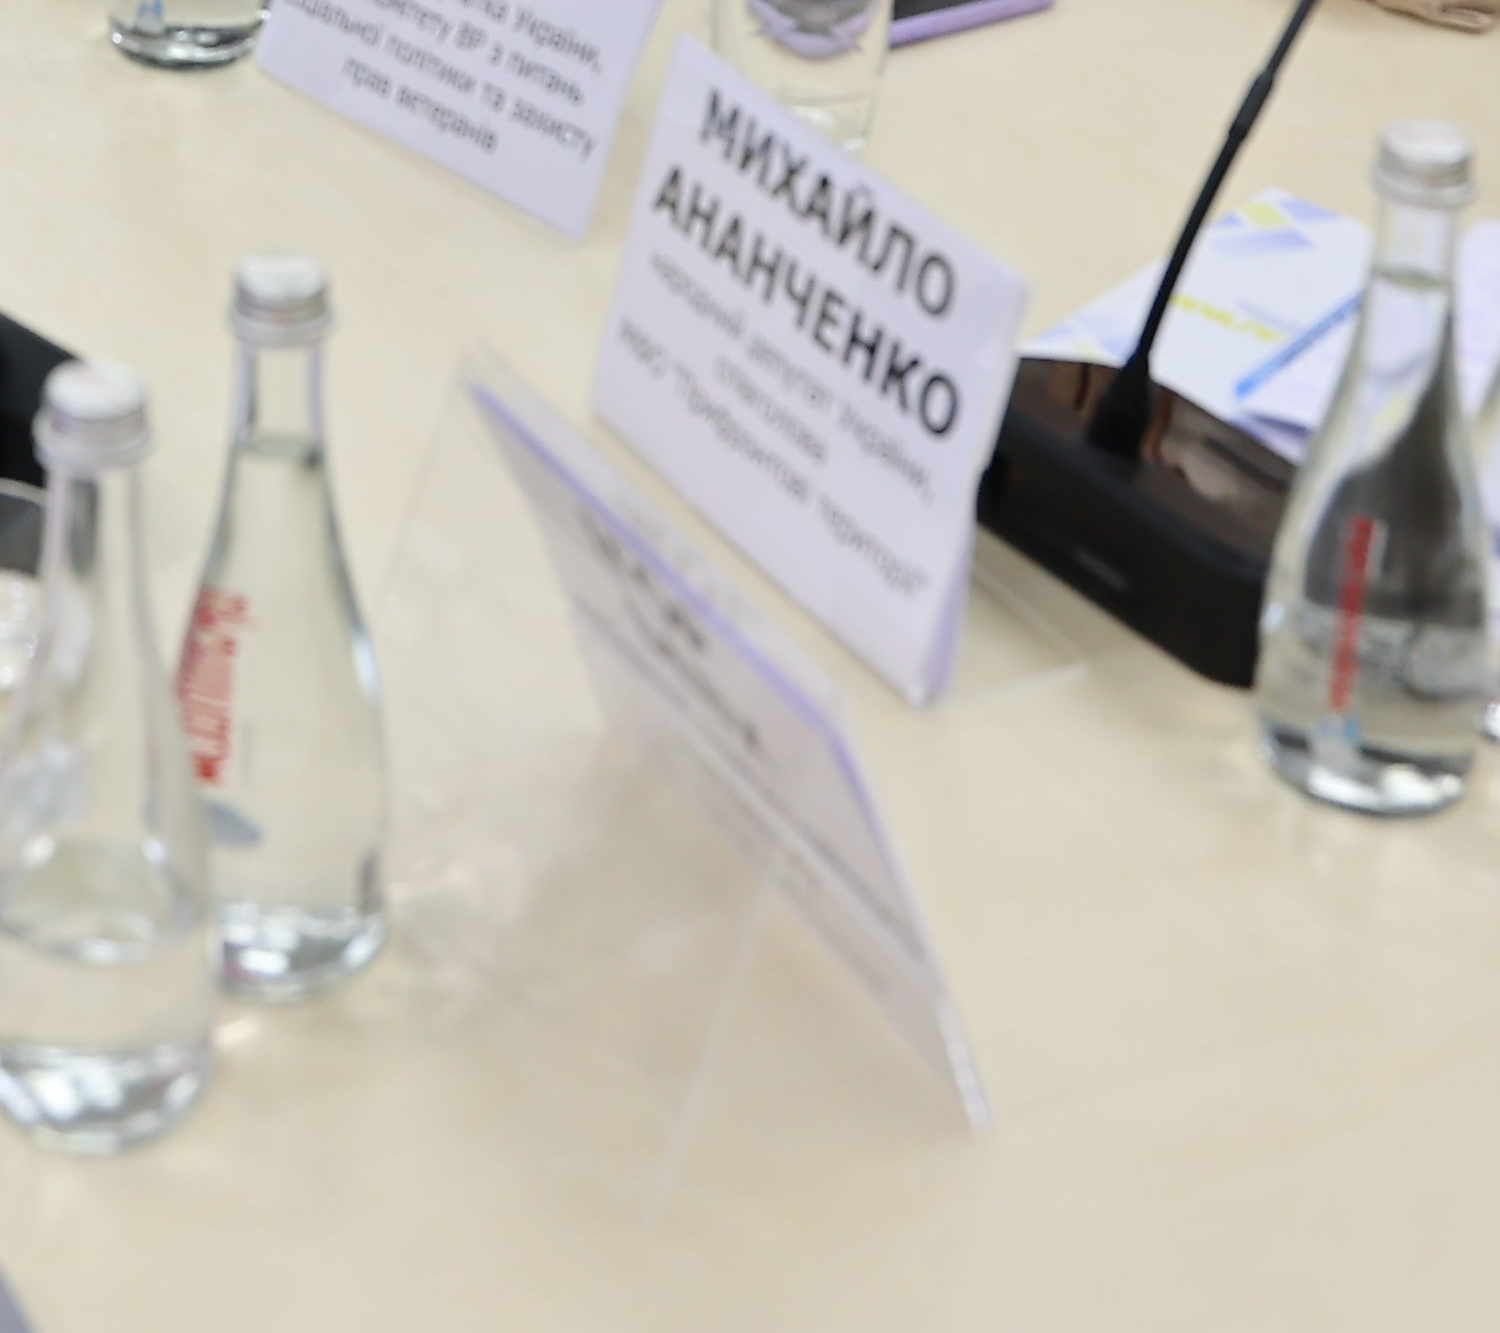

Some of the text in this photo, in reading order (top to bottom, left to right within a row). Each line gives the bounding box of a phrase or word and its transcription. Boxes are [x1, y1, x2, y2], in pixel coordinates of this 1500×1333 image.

[339, 54, 500, 158] прав ветеранів
[383, 32, 476, 98] політики
[478, 81, 508, 114] та
[509, 97, 597, 167] захисту
[454, 19, 487, 55] ВР
[504, 46, 588, 108] питань
[697, 83, 961, 320] МИХАЙЛО
[653, 153, 960, 443] АНАНЧЕНКО
